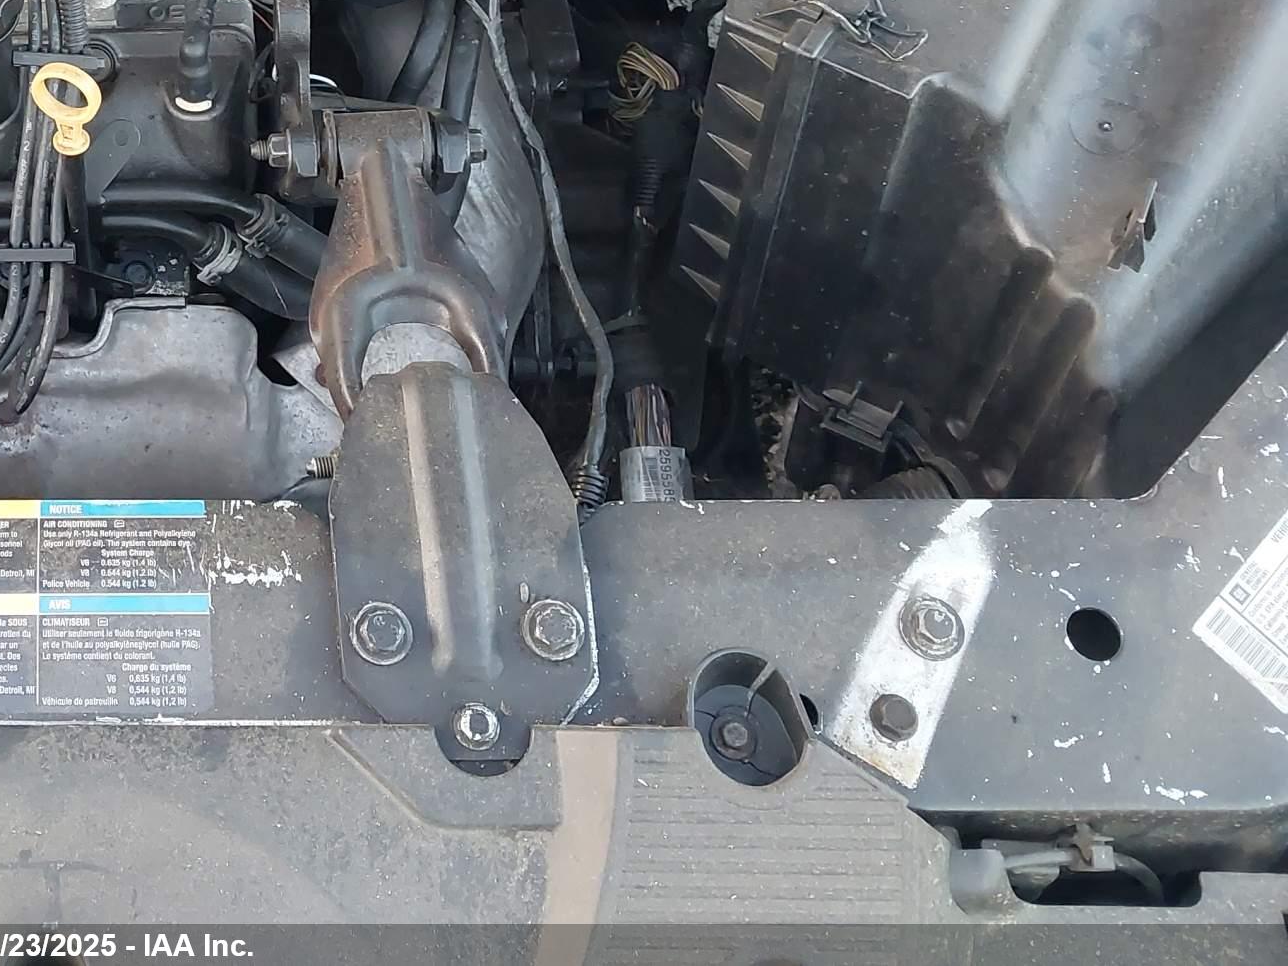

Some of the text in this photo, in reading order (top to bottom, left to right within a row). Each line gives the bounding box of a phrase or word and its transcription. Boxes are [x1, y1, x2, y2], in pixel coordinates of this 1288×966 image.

[49, 505, 83, 514] NOTICE
[43, 520, 108, 528] AIR CONDITIONING
[43, 529, 197, 539] Use only R-134a Refrigerant and Polyalkylene
[43, 539, 64, 548] Glycol
[75, 539, 92, 548] (PAG
[107, 539, 120, 548] The
[121, 539, 145, 549] system
[146, 539, 176, 548] contains
[177, 539, 192, 548] dye.
[101, 549, 155, 558] System Charge
[0, 570, 24, 579] Detroit,
[43, 579, 63, 588] Police
[64, 579, 91, 588] Vehicle
[100, 579, 121, 588] 0.544
[132, 579, 146, 588] (1.2
[49, 600, 72, 610] AVIS
[7, 618, 28, 627] SOUS
[42, 618, 91, 627] CLIMATISEUR
[122, 663, 148, 673] Charge
[161, 663, 192, 672] système
[0, 686, 24, 696] Detroit,
